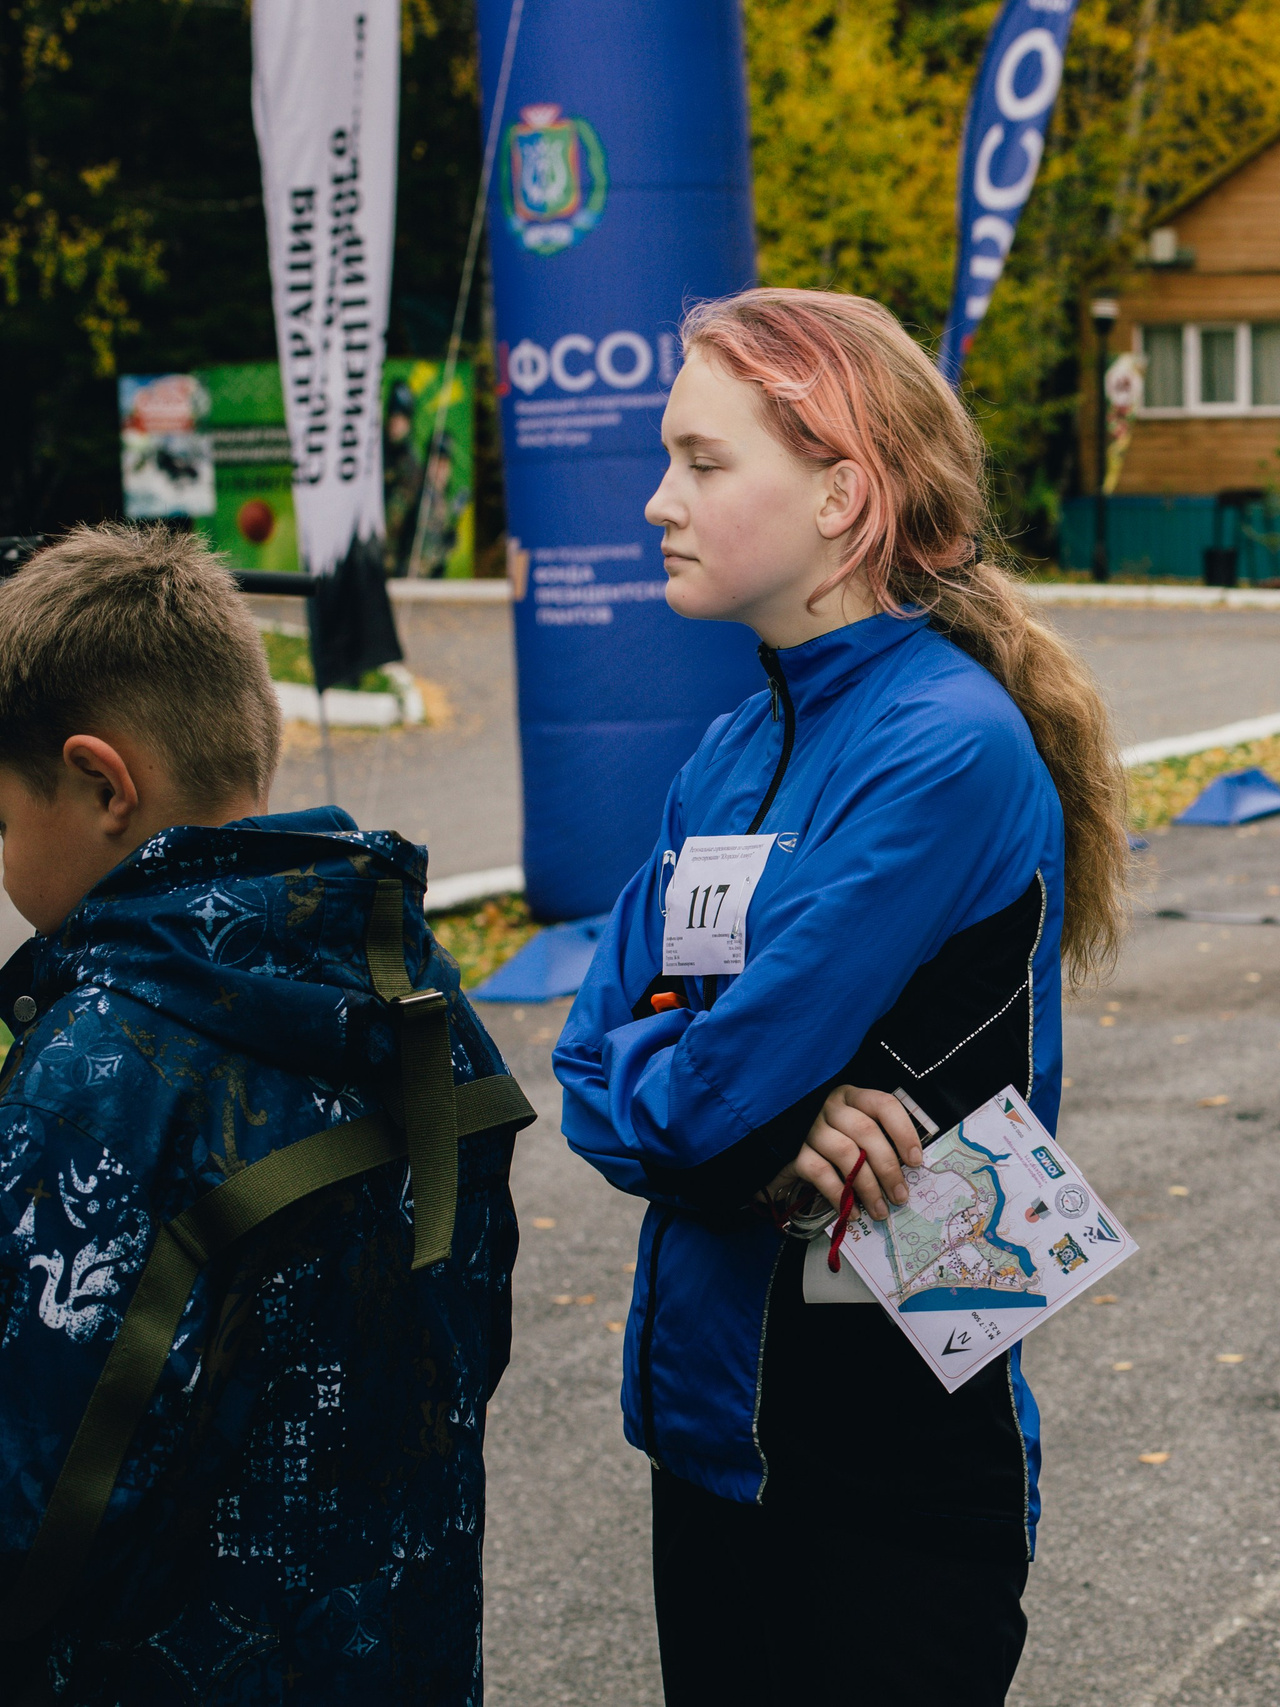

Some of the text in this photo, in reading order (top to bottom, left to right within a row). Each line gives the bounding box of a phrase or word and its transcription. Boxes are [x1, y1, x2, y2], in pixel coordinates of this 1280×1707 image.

[686, 884, 731, 930] 117
[1036, 1150, 1060, 1177] ЮМС
[970, 1310, 981, 1322] 500
[987, 1320, 998, 1331] 2,5
[956, 1330, 972, 1345] N
